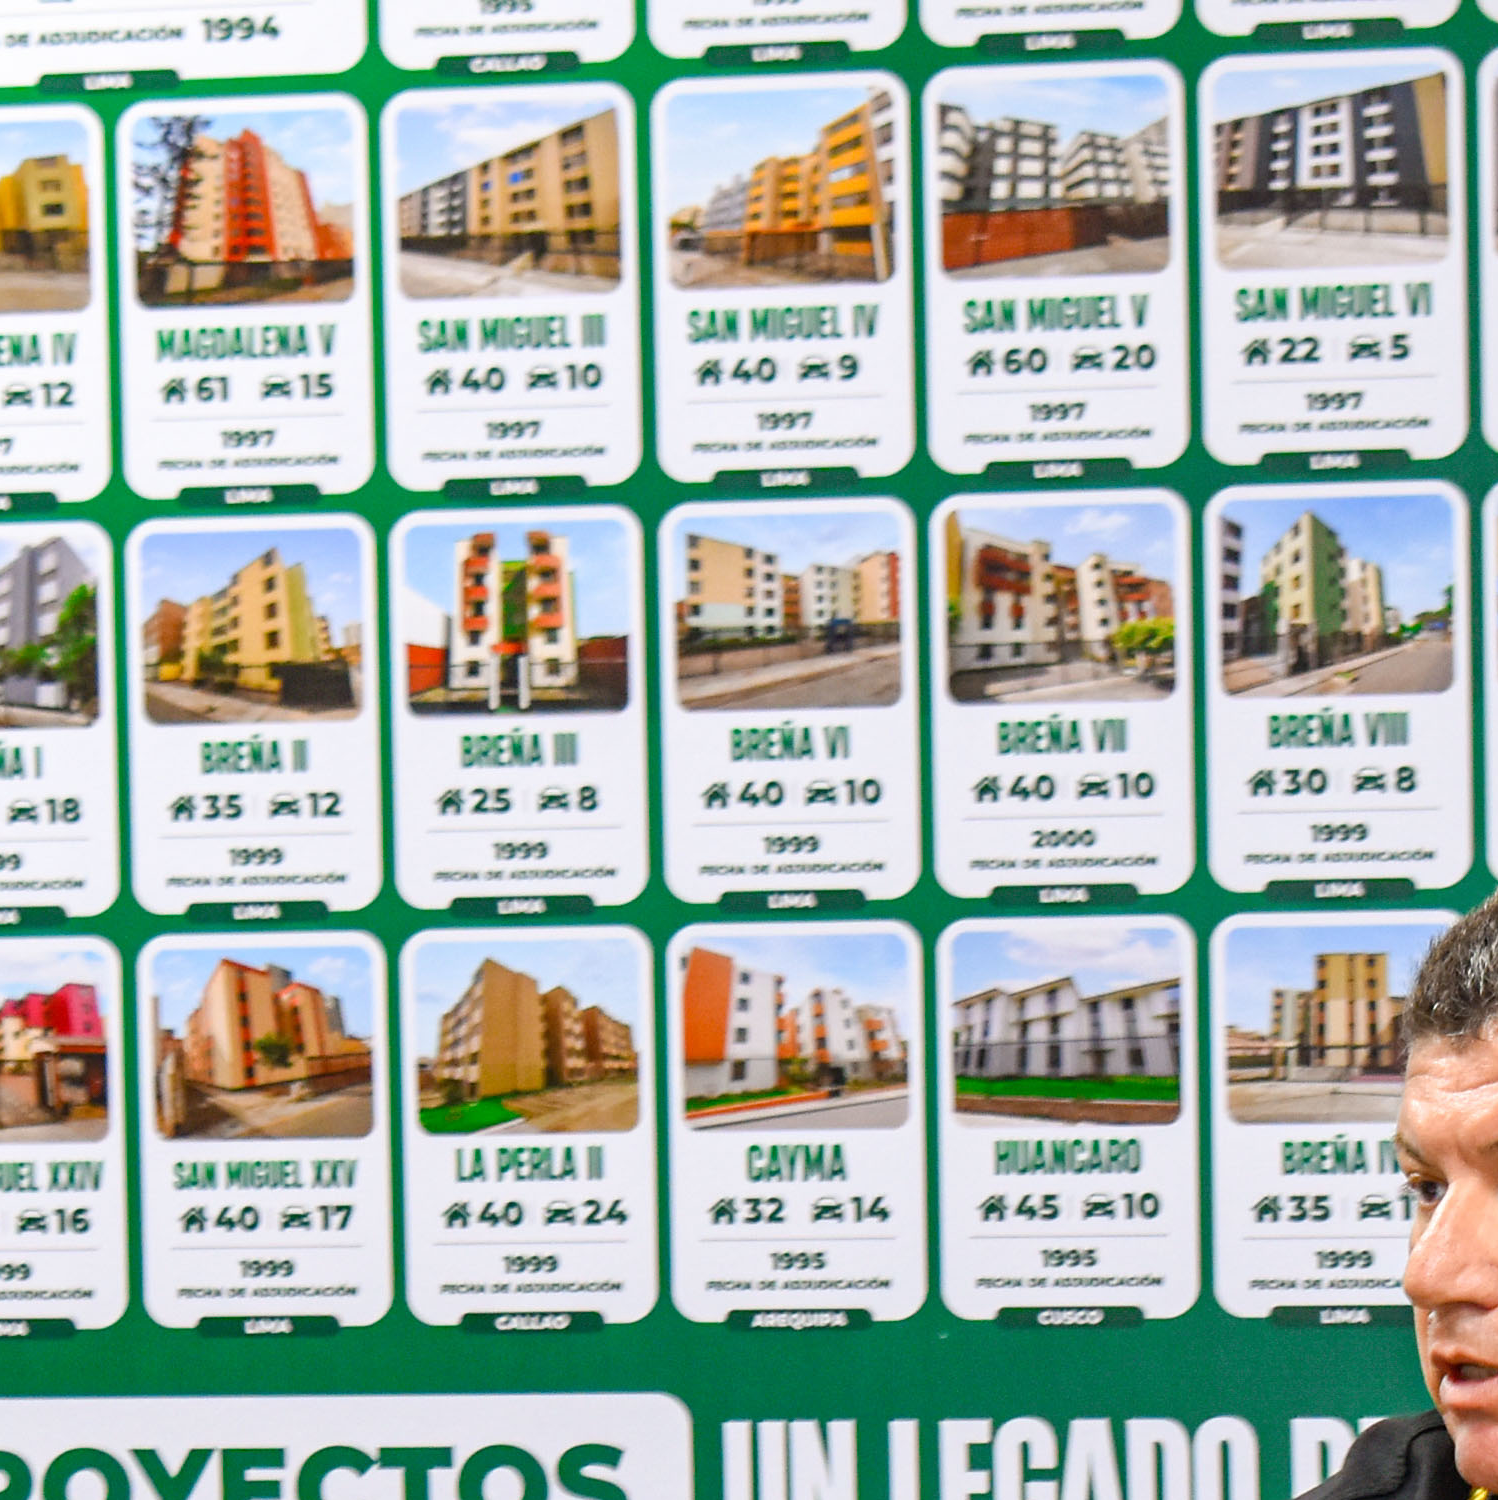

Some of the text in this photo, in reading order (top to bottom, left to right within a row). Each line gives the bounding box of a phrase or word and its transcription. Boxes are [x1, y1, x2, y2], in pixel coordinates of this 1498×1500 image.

[10, 33, 29, 48] DE
[202, 16, 281, 42] 1994
[689, 304, 879, 343] SAN MIGUEL IV
[965, 294, 1149, 334] SAN MIGUEL V
[157, 324, 336, 360] MAGDALENA V
[420, 313, 607, 353] SAN MIGUEL III
[1279, 334, 1410, 364] 22 5
[195, 373, 334, 402] 61 15
[999, 714, 1128, 755] BREÑA VII
[1269, 707, 1410, 749] BREÑA VIII
[34, 746, 43, 779] I
[201, 734, 309, 774] BREÑA II
[738, 779, 882, 807] 40 10
[457, 1146, 604, 1182] LA PERLA II
[747, 1144, 846, 1182] CAYMA
[996, 1138, 1141, 1175] HUANCARO
[1283, 1134, 1368, 1175] BREÑA
[49, 1161, 103, 1192] XXIV
[215, 1205, 353, 1231] 40 17
[771, 1252, 827, 1270] 1995
